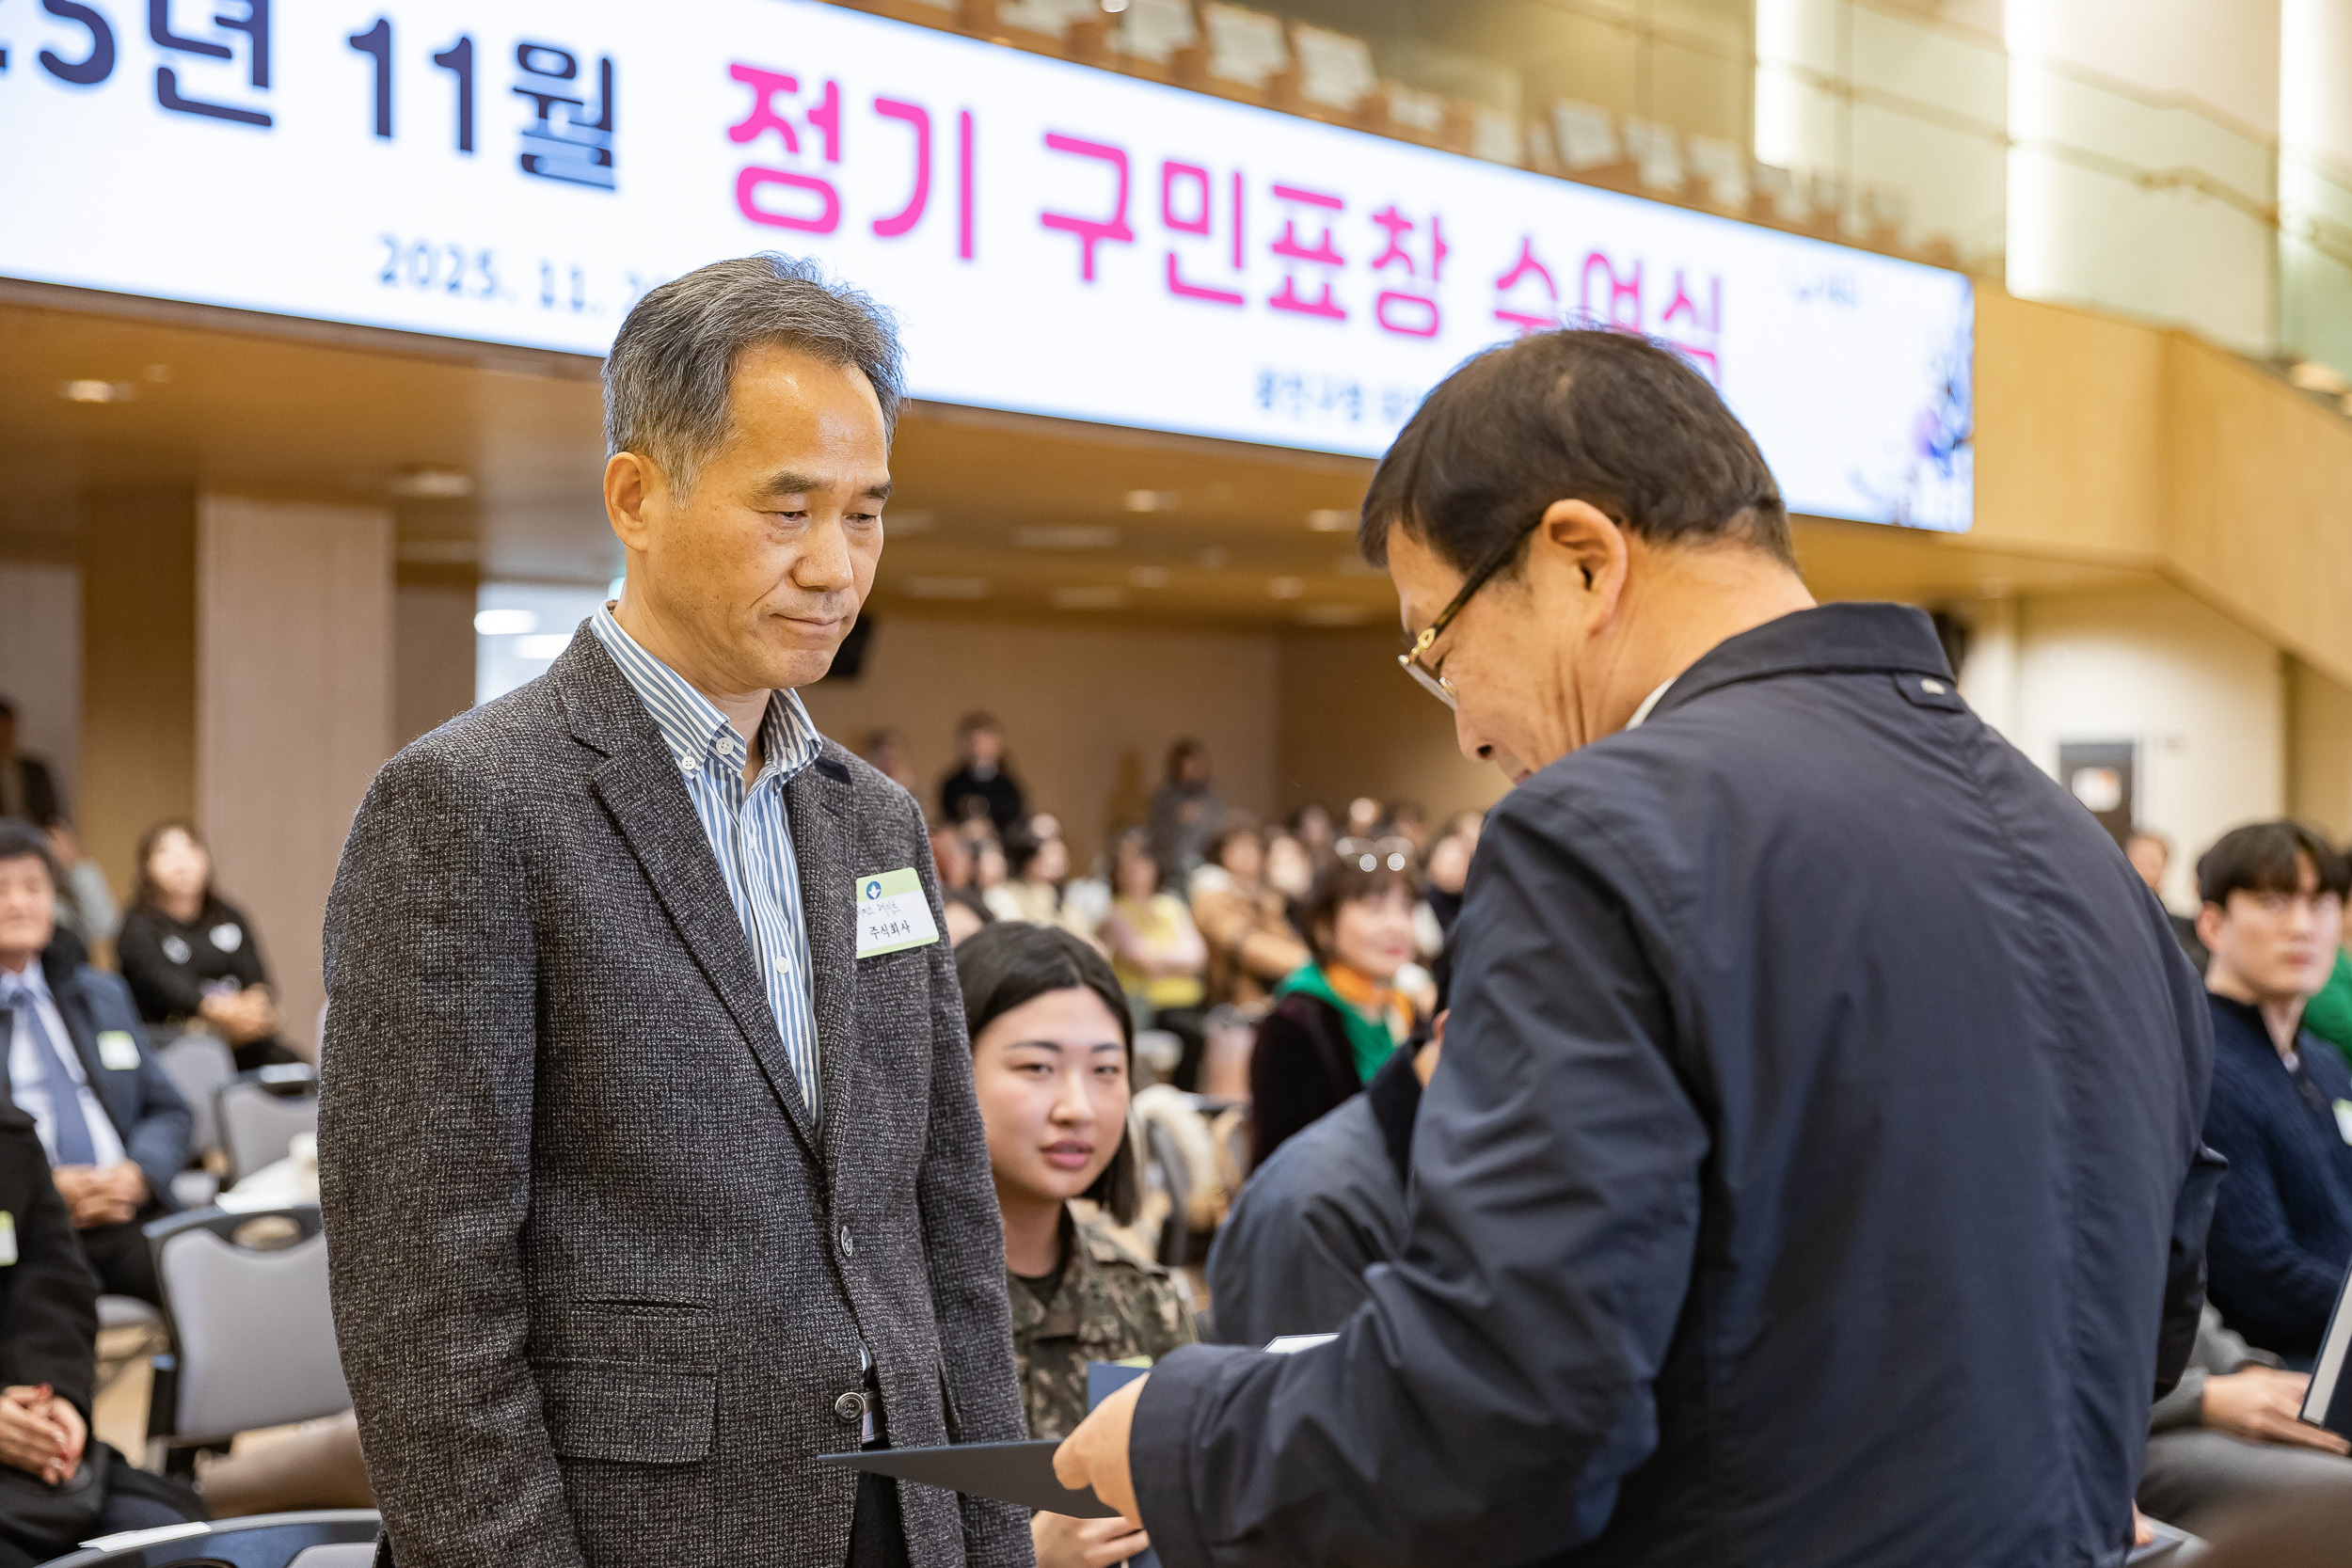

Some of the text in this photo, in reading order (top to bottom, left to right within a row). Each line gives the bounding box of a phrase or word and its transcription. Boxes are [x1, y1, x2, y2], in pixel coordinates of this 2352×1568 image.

[0, 0, 273, 127] 5년
[348, 18, 617, 192] 11월
[728, 62, 974, 261] 정기
[1041, 132, 1449, 338] 구민표창
[376, 232, 519, 302] 2025.
[869, 919, 911, 940] 주식회사
